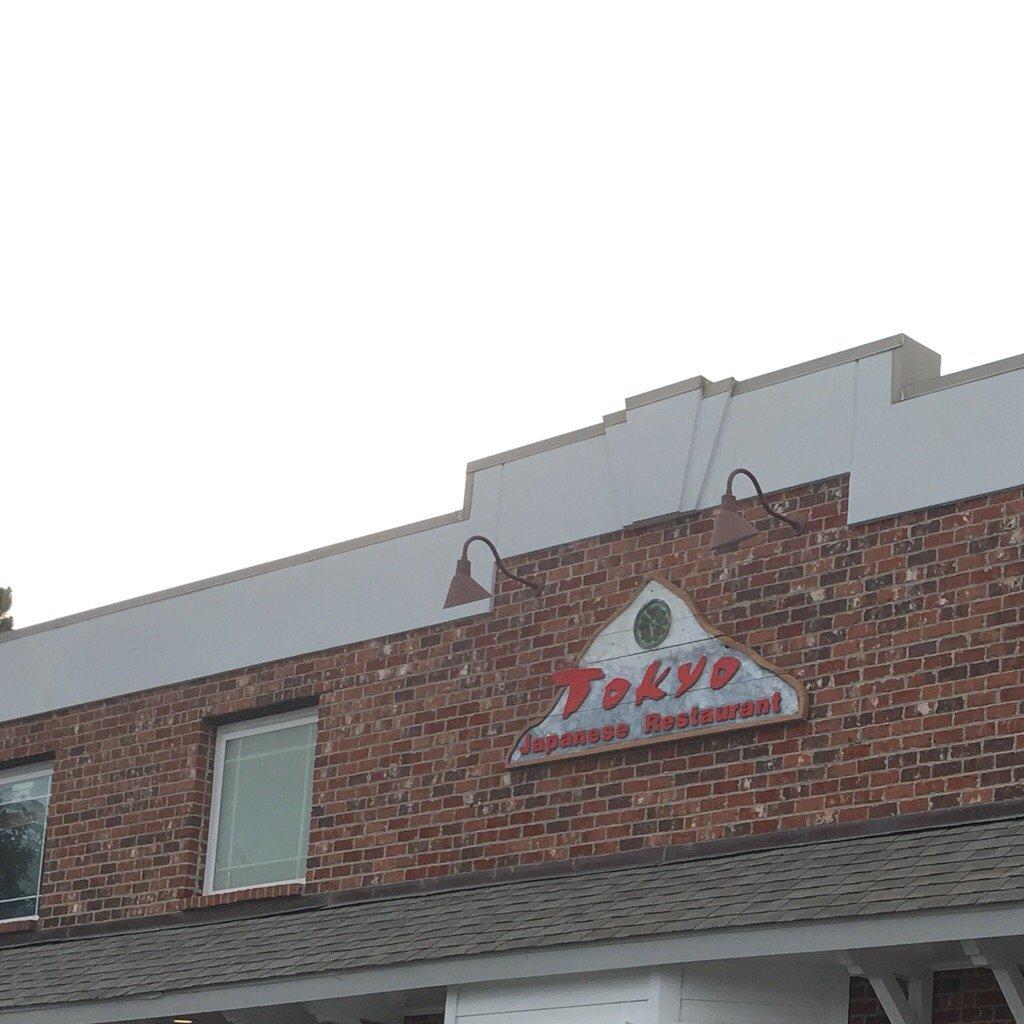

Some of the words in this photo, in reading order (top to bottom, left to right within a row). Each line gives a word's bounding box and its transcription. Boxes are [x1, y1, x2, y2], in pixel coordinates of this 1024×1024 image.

[552, 655, 742, 720] Tokyo
[519, 722, 630, 755] Japanese
[643, 691, 783, 735] Restaurant
